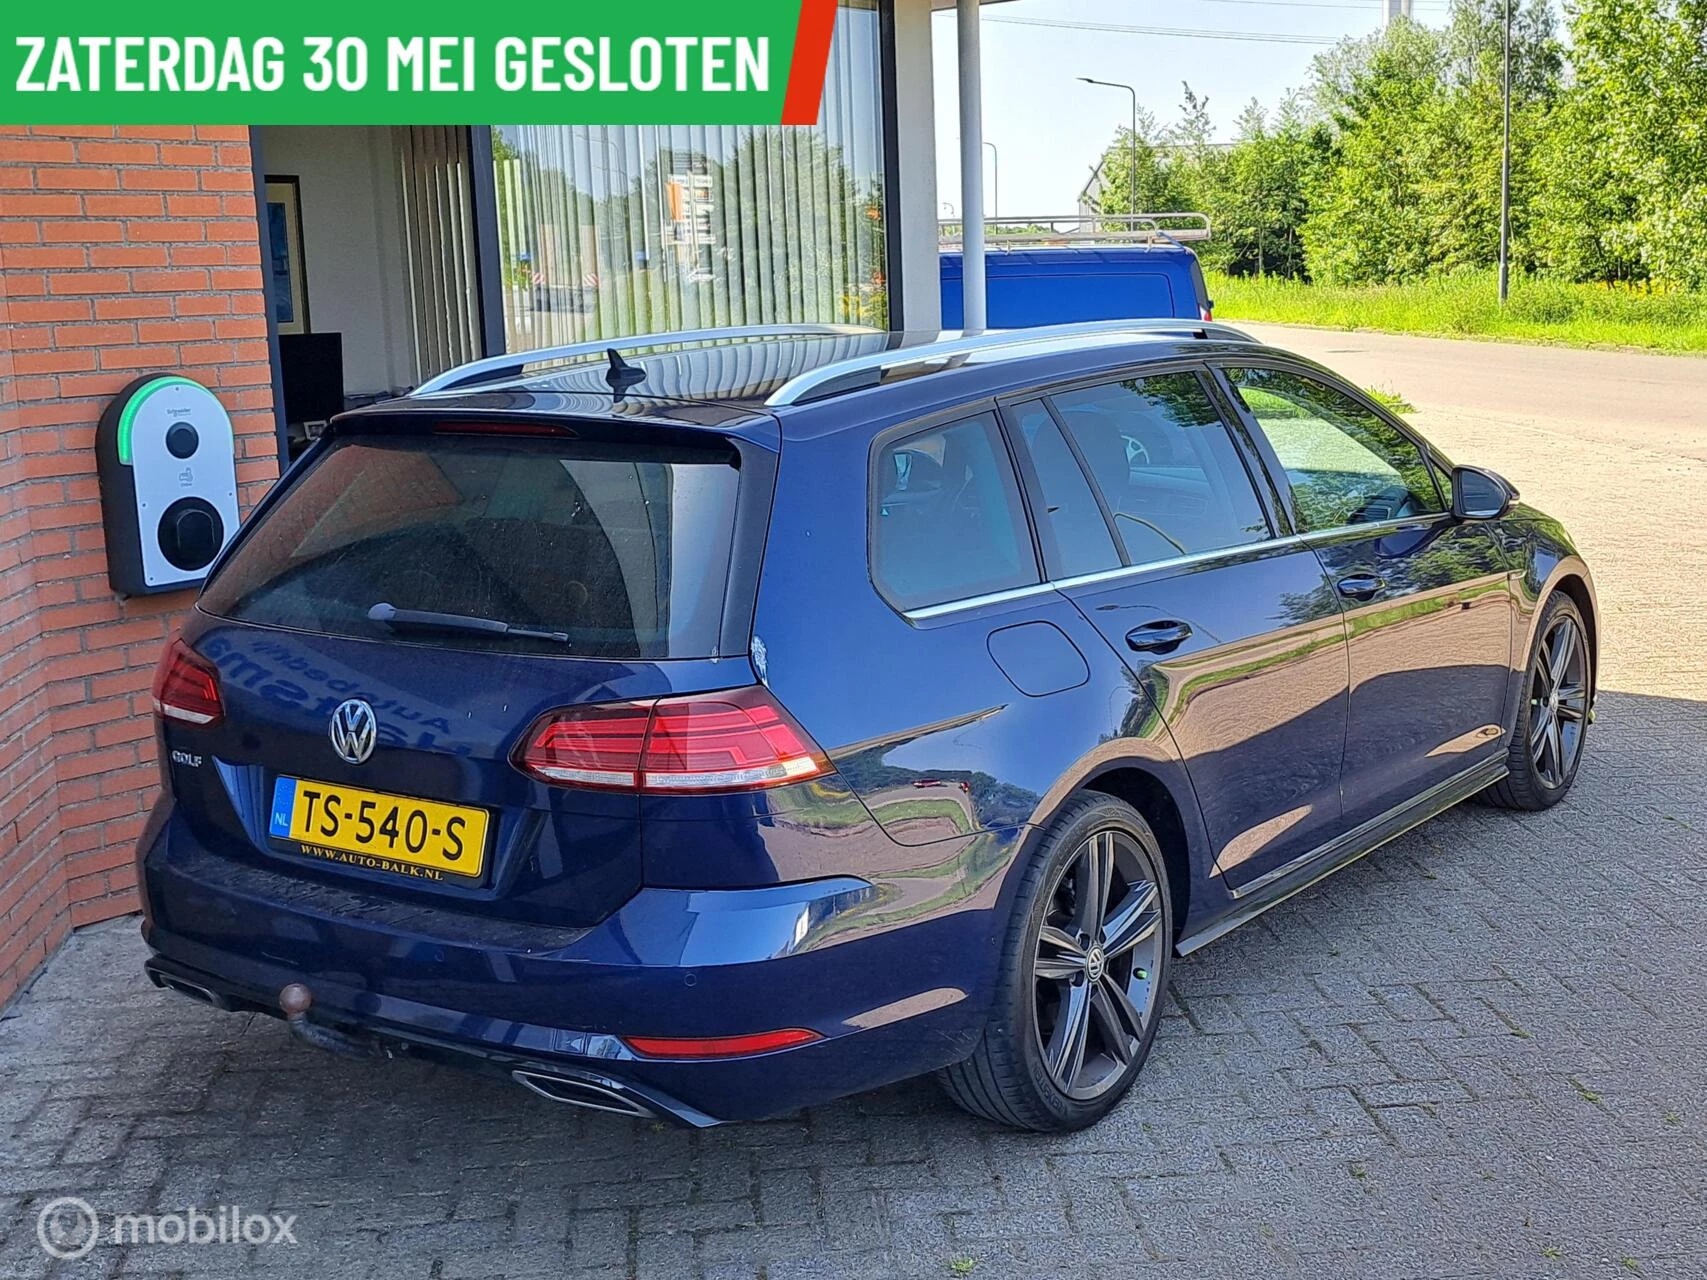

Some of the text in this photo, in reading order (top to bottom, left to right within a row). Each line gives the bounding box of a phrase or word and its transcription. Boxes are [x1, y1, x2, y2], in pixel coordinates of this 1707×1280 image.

[171, 750, 202, 768] GOLF
[274, 811, 289, 827] NL
[302, 790, 466, 861] TS-540-S
[300, 844, 444, 881] WWW.AUTO-BALK.NL
